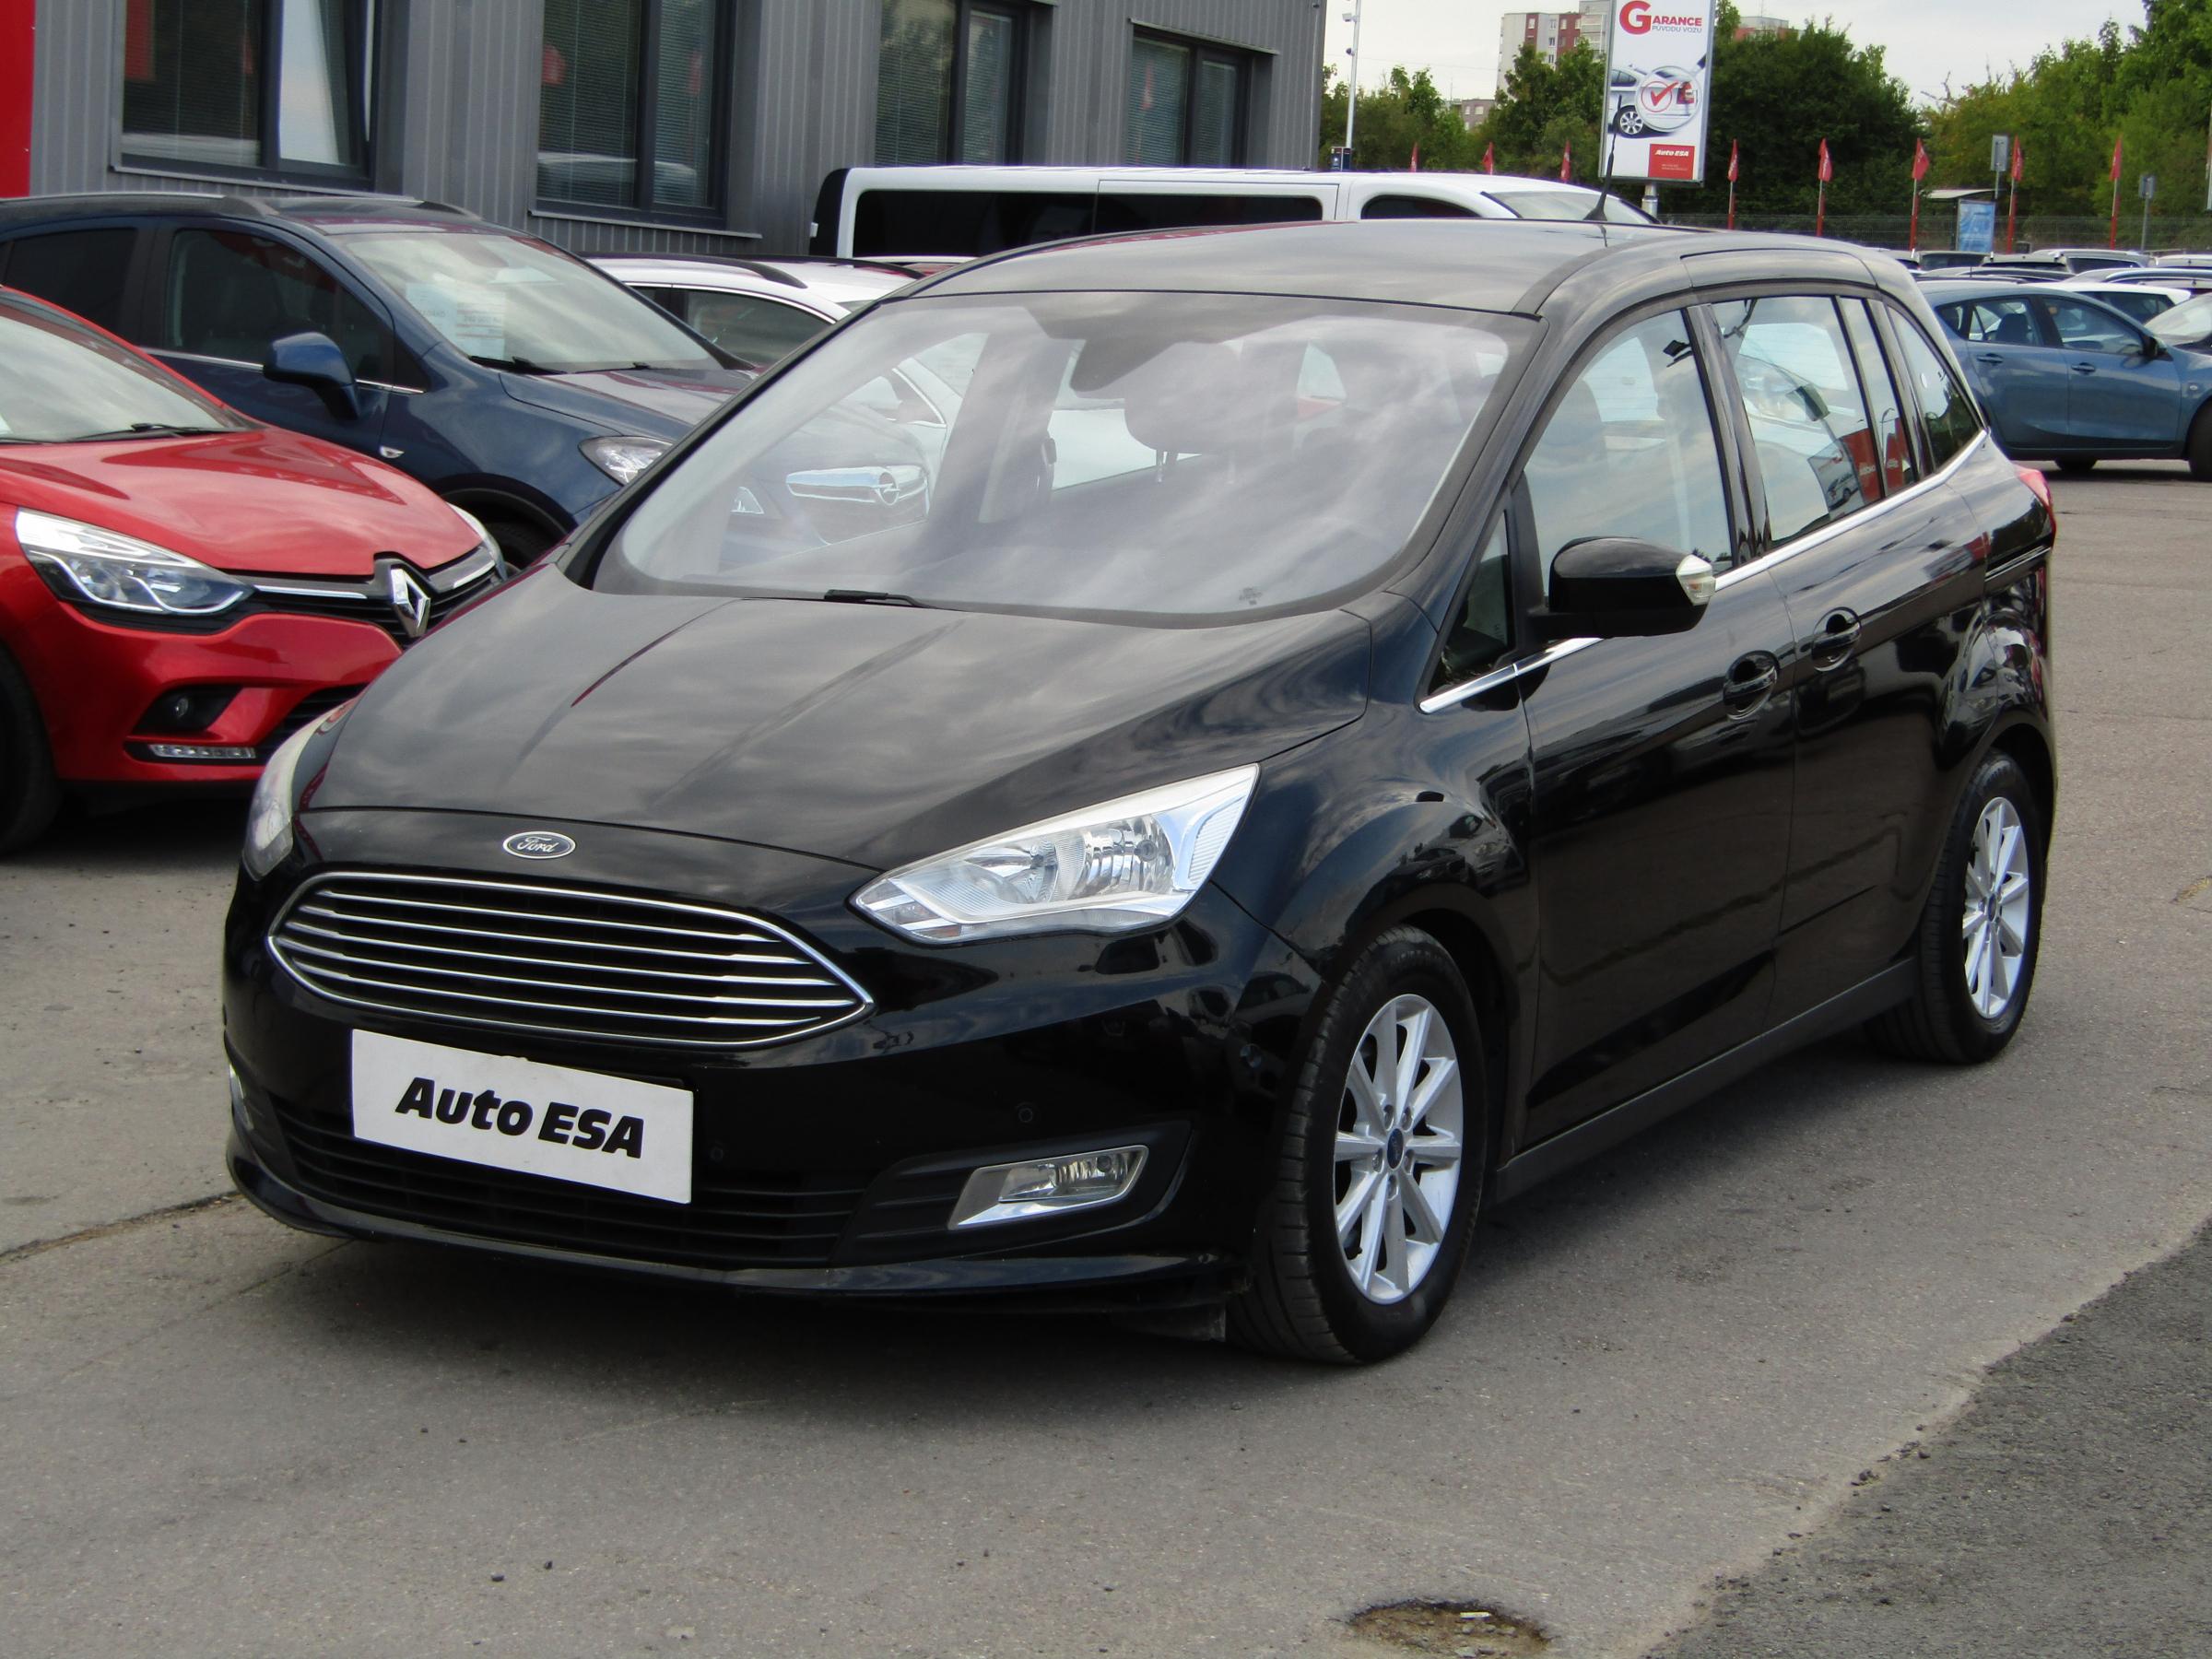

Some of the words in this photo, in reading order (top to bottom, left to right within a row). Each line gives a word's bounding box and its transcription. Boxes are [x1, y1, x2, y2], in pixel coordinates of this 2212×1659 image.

[1619, 1, 1702, 35] GARANCE
[517, 836, 559, 853] Ford
[394, 1077, 534, 1135] Auto
[537, 1101, 644, 1159] ESA
